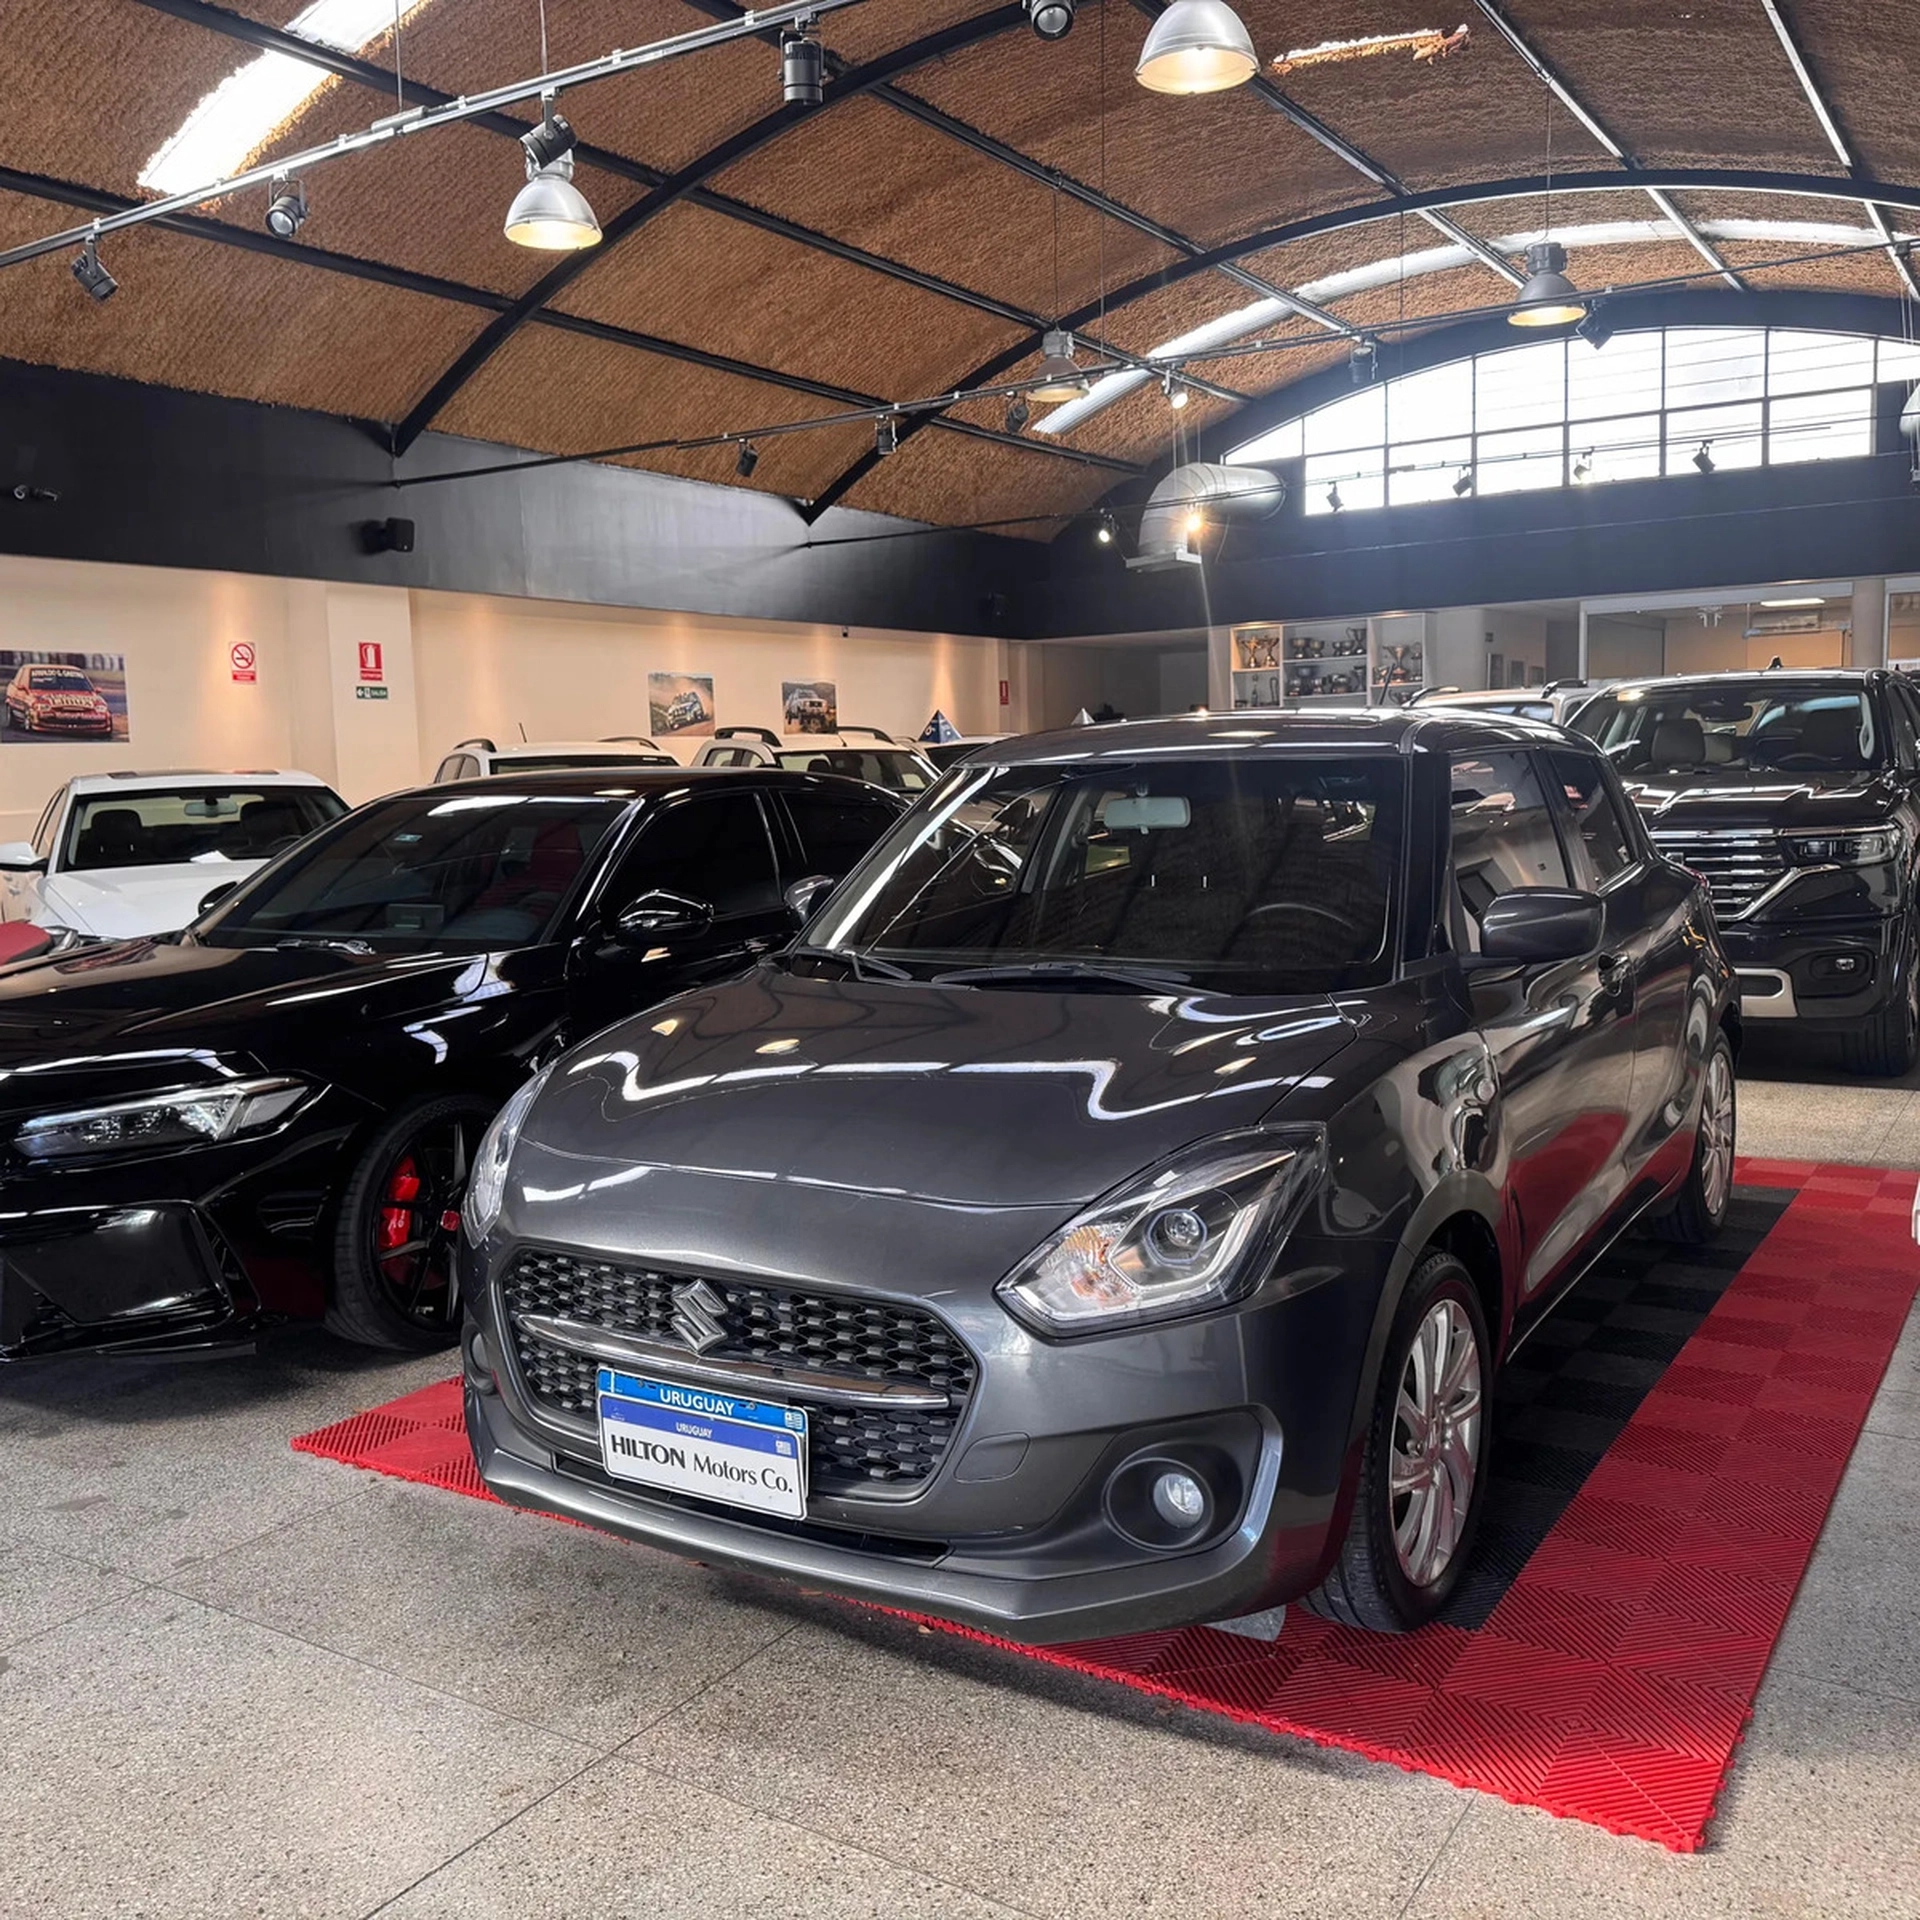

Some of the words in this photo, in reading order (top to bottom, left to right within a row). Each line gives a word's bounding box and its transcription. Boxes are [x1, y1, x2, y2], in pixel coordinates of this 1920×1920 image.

[659, 1388, 735, 1416] URUGUAY
[675, 1422, 713, 1439] URUGUAY
[611, 1434, 686, 1469] HILTON
[693, 1453, 758, 1486] Motors
[761, 1468, 794, 1493] Co.
